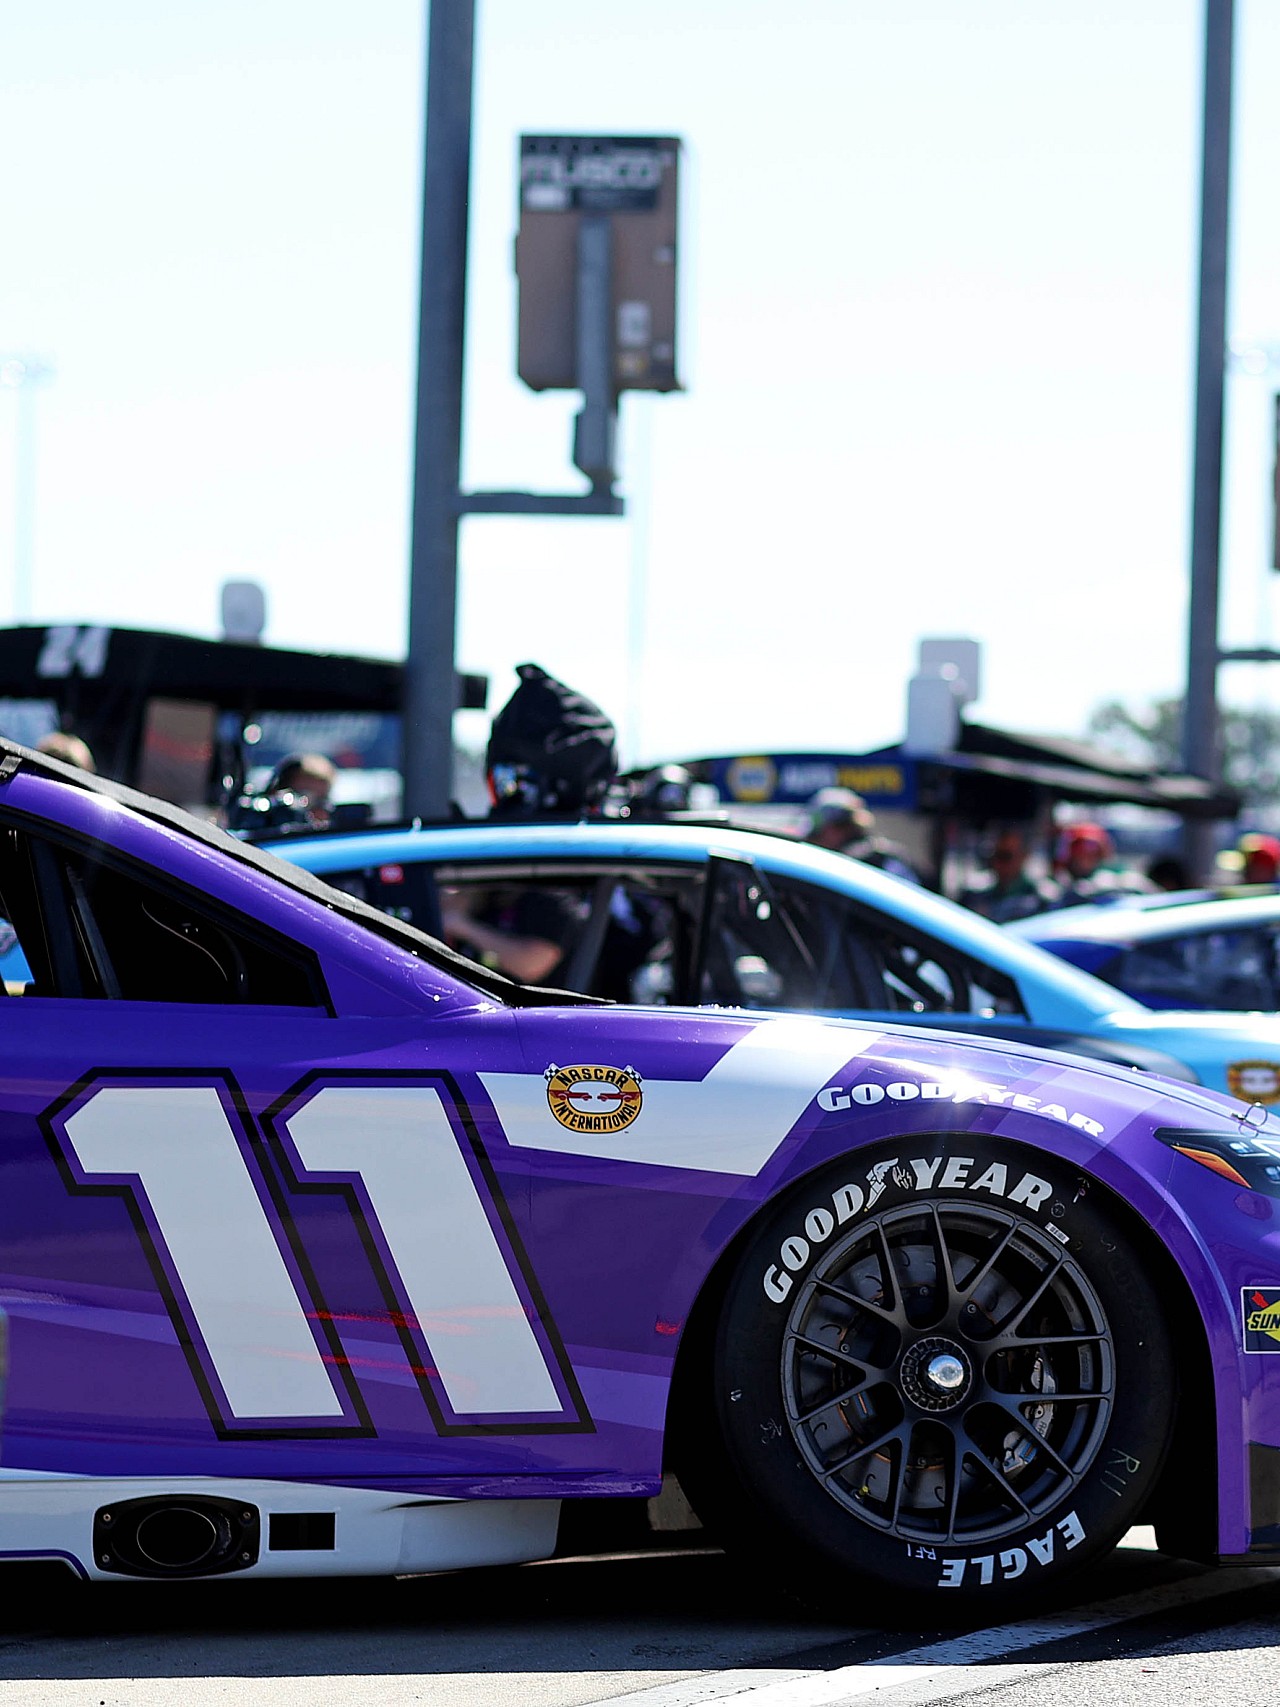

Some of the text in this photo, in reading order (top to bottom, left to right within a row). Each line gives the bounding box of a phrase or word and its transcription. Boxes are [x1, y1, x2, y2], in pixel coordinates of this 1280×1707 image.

[37, 626, 111, 679] 24
[555, 1068, 629, 1089] NASCAR
[553, 1101, 638, 1131] INTERNATIONAL
[37, 1066, 597, 1440] 11
[937, 1510, 1087, 1588] EAGLE
